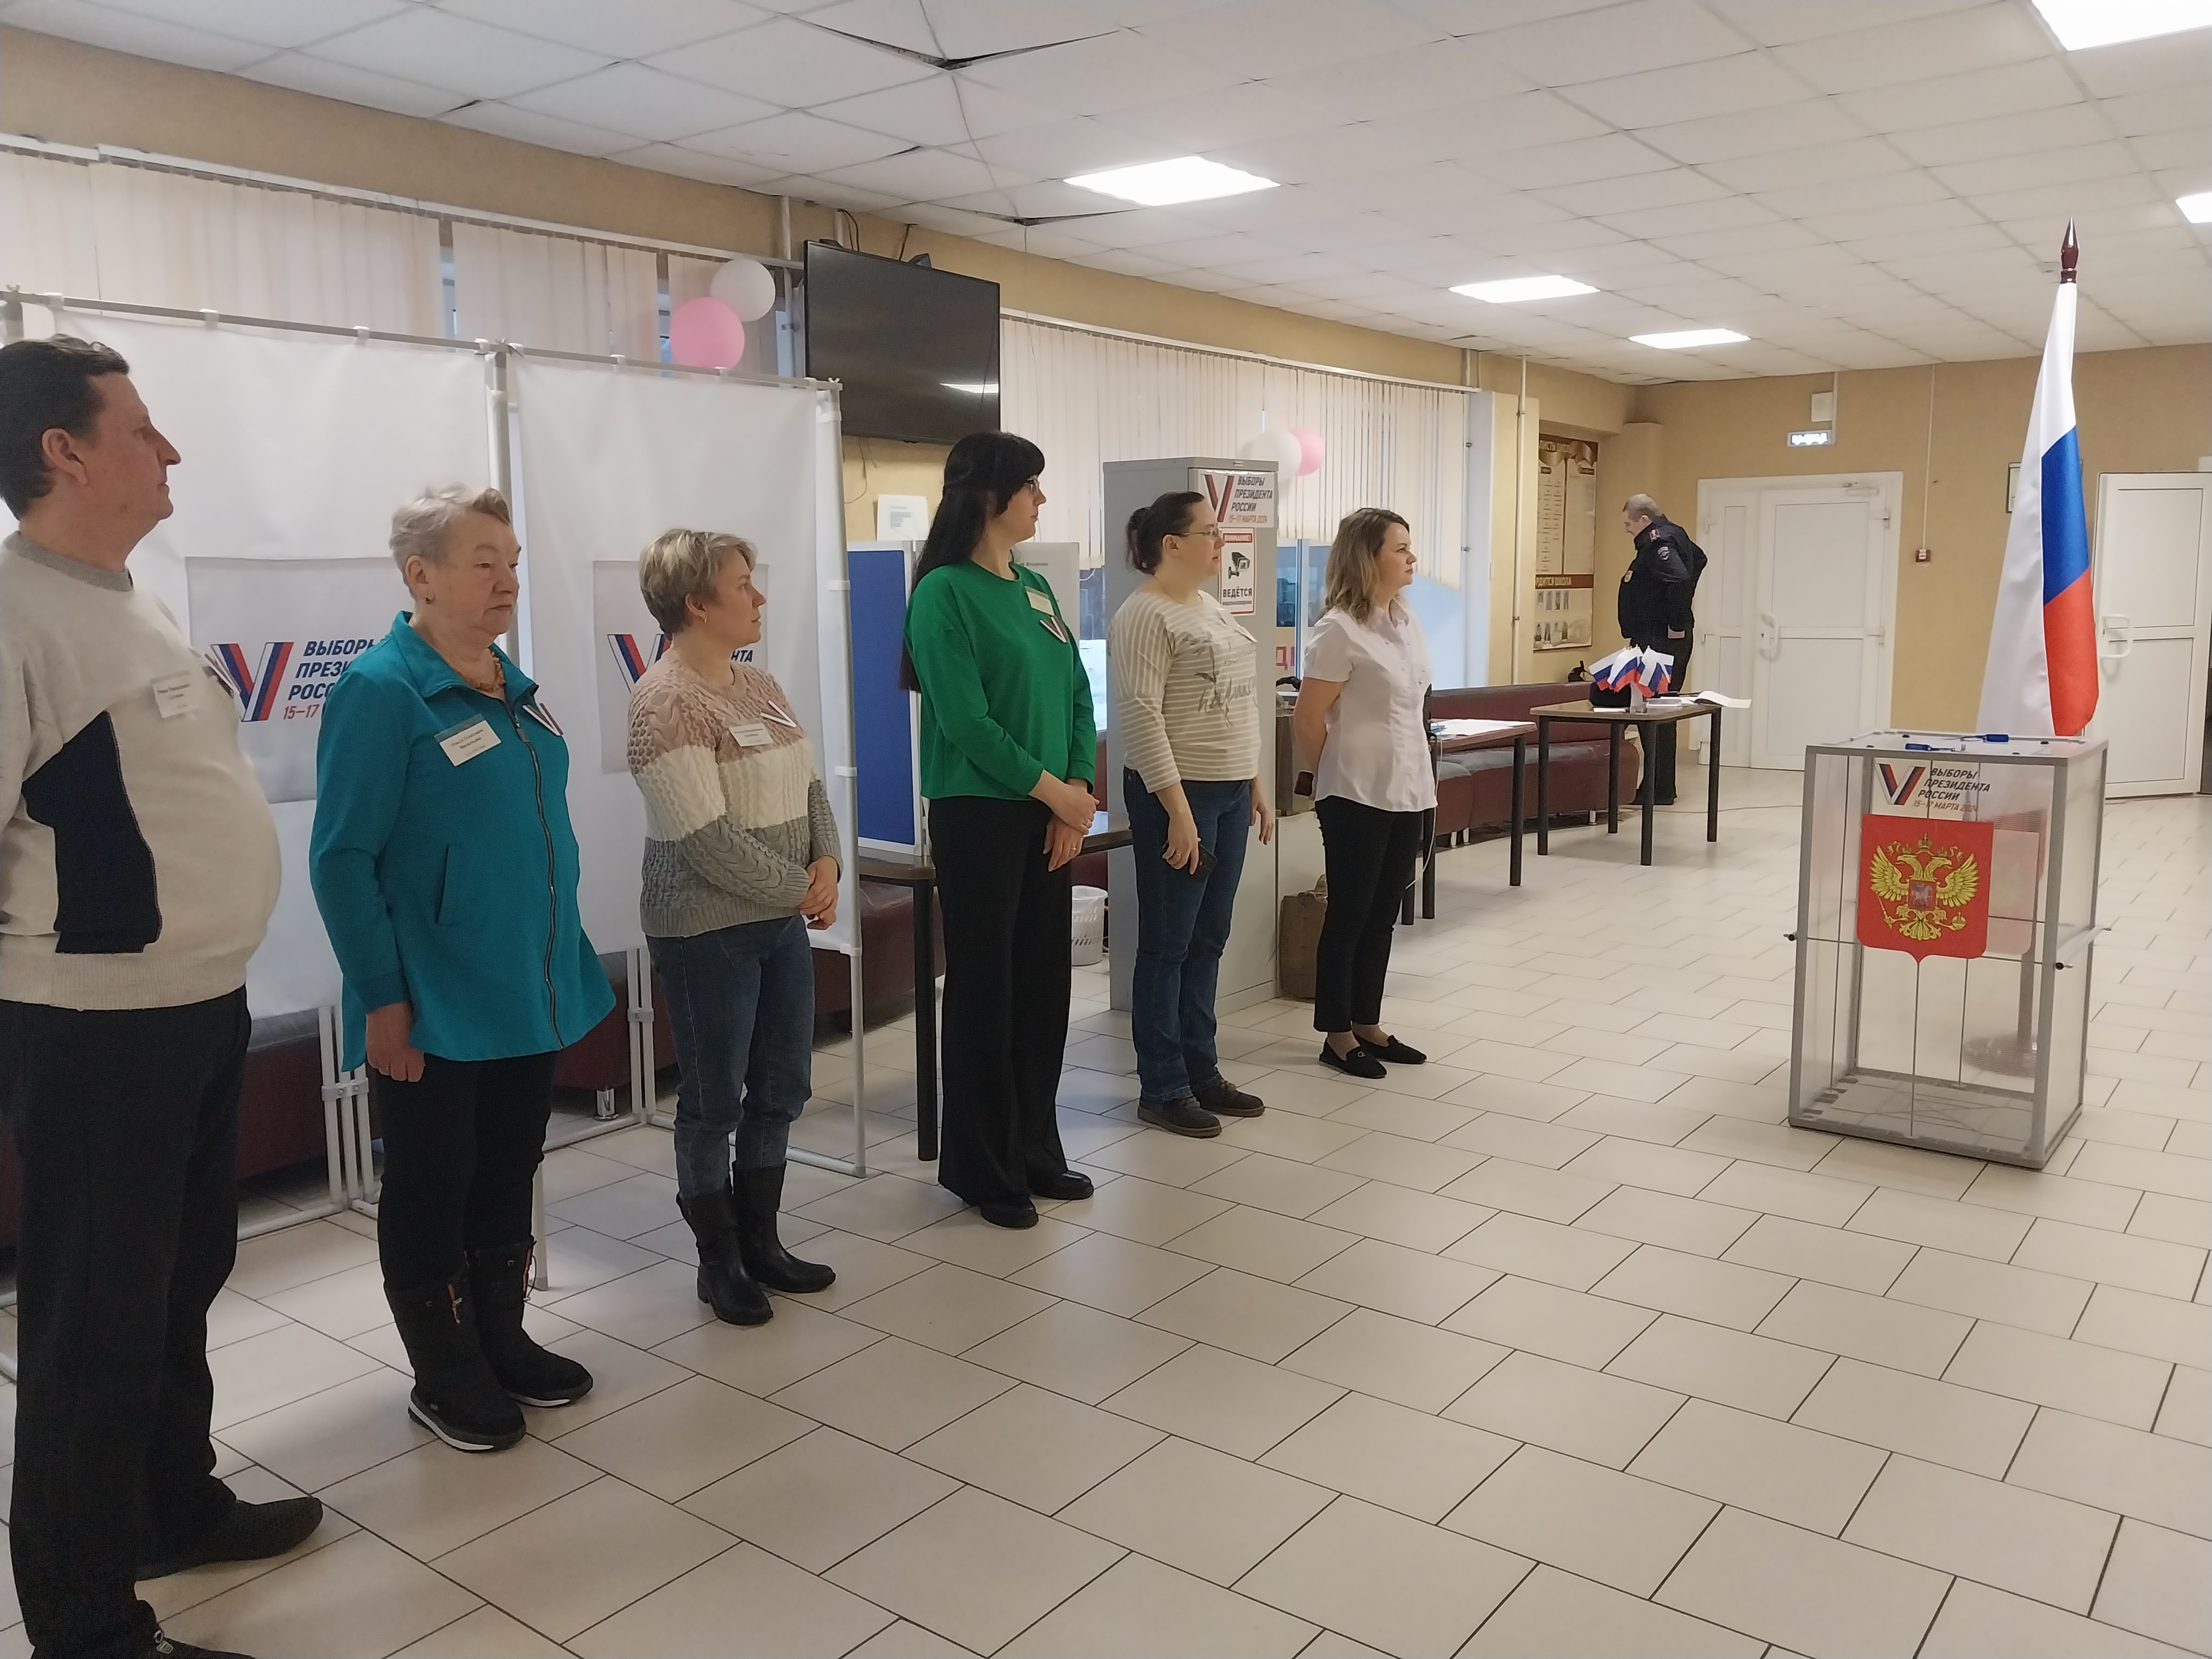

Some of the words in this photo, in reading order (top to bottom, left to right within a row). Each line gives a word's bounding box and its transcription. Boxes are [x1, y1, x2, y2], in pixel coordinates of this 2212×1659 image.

[1238, 476, 1265, 486] ВЫБОРЫ
[1234, 489, 1273, 500] ПРЕЗИДЕНТА
[1231, 502, 1257, 512] РОССИИ
[1223, 587, 1252, 599] ВЕДЁТСЯ
[1930, 768, 1978, 780] ВЫБОРЫ
[1924, 779, 1991, 792] ПРЕЗИДЕНТА
[1917, 789, 1960, 801] РОССИИ
[1933, 802, 1959, 811] МАРТА
